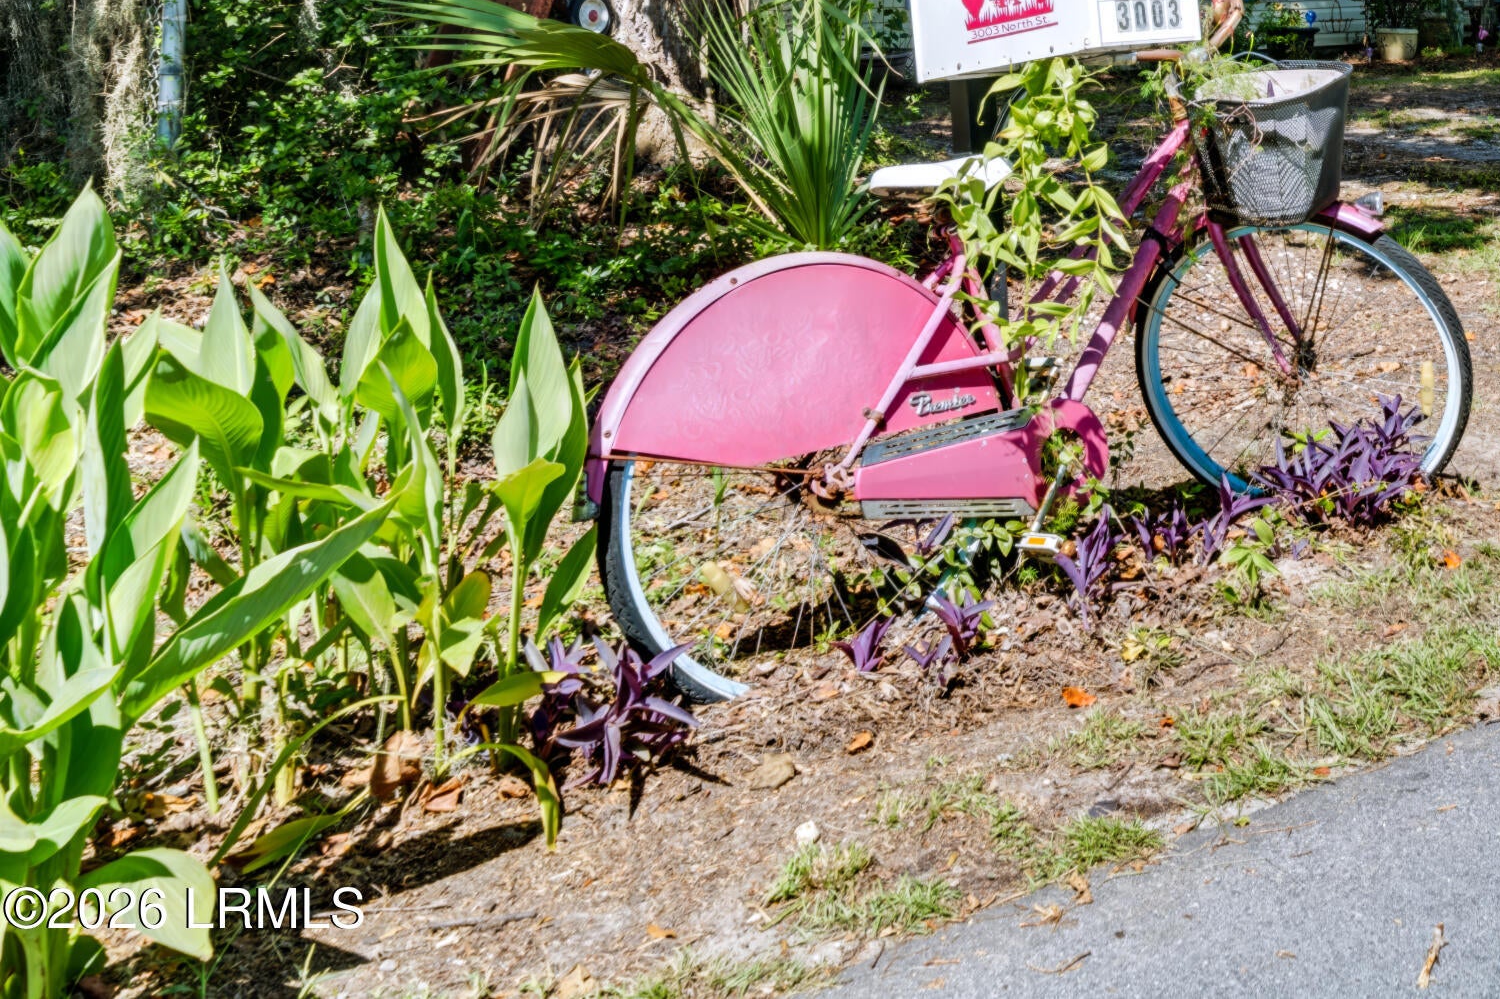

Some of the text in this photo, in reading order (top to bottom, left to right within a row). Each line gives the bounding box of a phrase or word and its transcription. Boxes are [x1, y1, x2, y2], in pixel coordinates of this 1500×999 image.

[1117, 0, 1180, 30] 3003
[971, 25, 1000, 40] 3003
[1001, 17, 1034, 32] North
